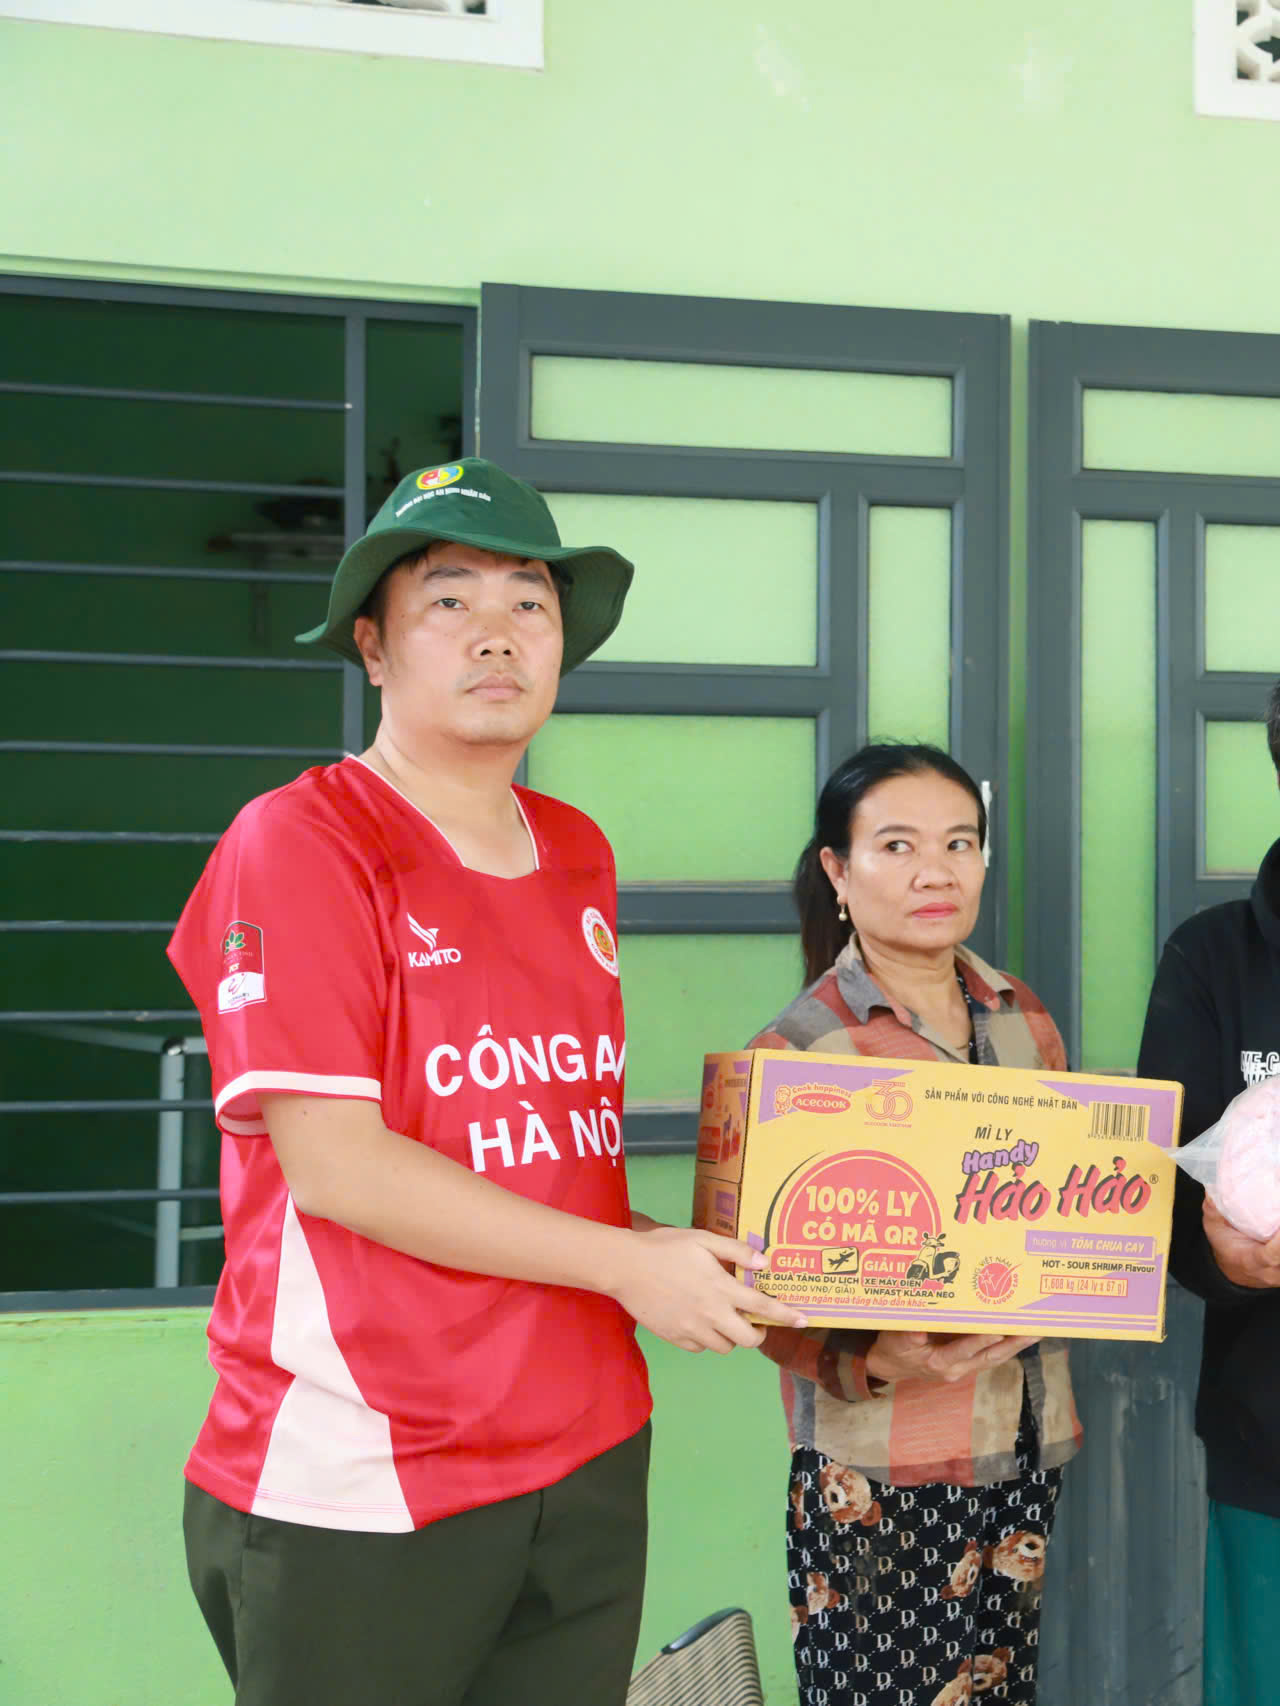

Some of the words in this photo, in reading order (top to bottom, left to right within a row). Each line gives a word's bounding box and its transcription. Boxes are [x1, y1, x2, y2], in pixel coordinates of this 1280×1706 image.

[408, 948, 461, 967] KAMITO
[425, 1024, 588, 1097] CÔNG
[944, 1088, 968, 1103] PHẨM
[987, 1092, 1009, 1105] CÔNG
[1012, 1096, 1034, 1108] NGHỆ
[1037, 1097, 1058, 1110] NHẬT
[468, 1100, 561, 1173] HÀ
[569, 1096, 622, 1167] NỘ
[974, 1124, 992, 1140] MÌ
[995, 1127, 1013, 1141] LY
[962, 1139, 1039, 1175] Handy
[954, 1162, 1052, 1225] Hảo
[1057, 1155, 1152, 1218] Hảo
[806, 1185, 880, 1216] 100%
[886, 1190, 920, 1217] LY
[802, 1216, 836, 1241] CÓ
[841, 1219, 878, 1243] MÃ
[884, 1225, 919, 1246] QR
[776, 1252, 807, 1269] GIẢI
[863, 1256, 894, 1273] GIẢI
[1042, 1259, 1060, 1268] HOT
[1067, 1260, 1090, 1270] SOUR
[1092, 1262, 1123, 1271] SHRIMP
[1125, 1263, 1155, 1273] Flavour
[773, 1271, 794, 1281] QUÀ
[879, 1276, 898, 1286] MÁY
[864, 1287, 901, 1296] VINFAST
[903, 1290, 933, 1298] KLARA
